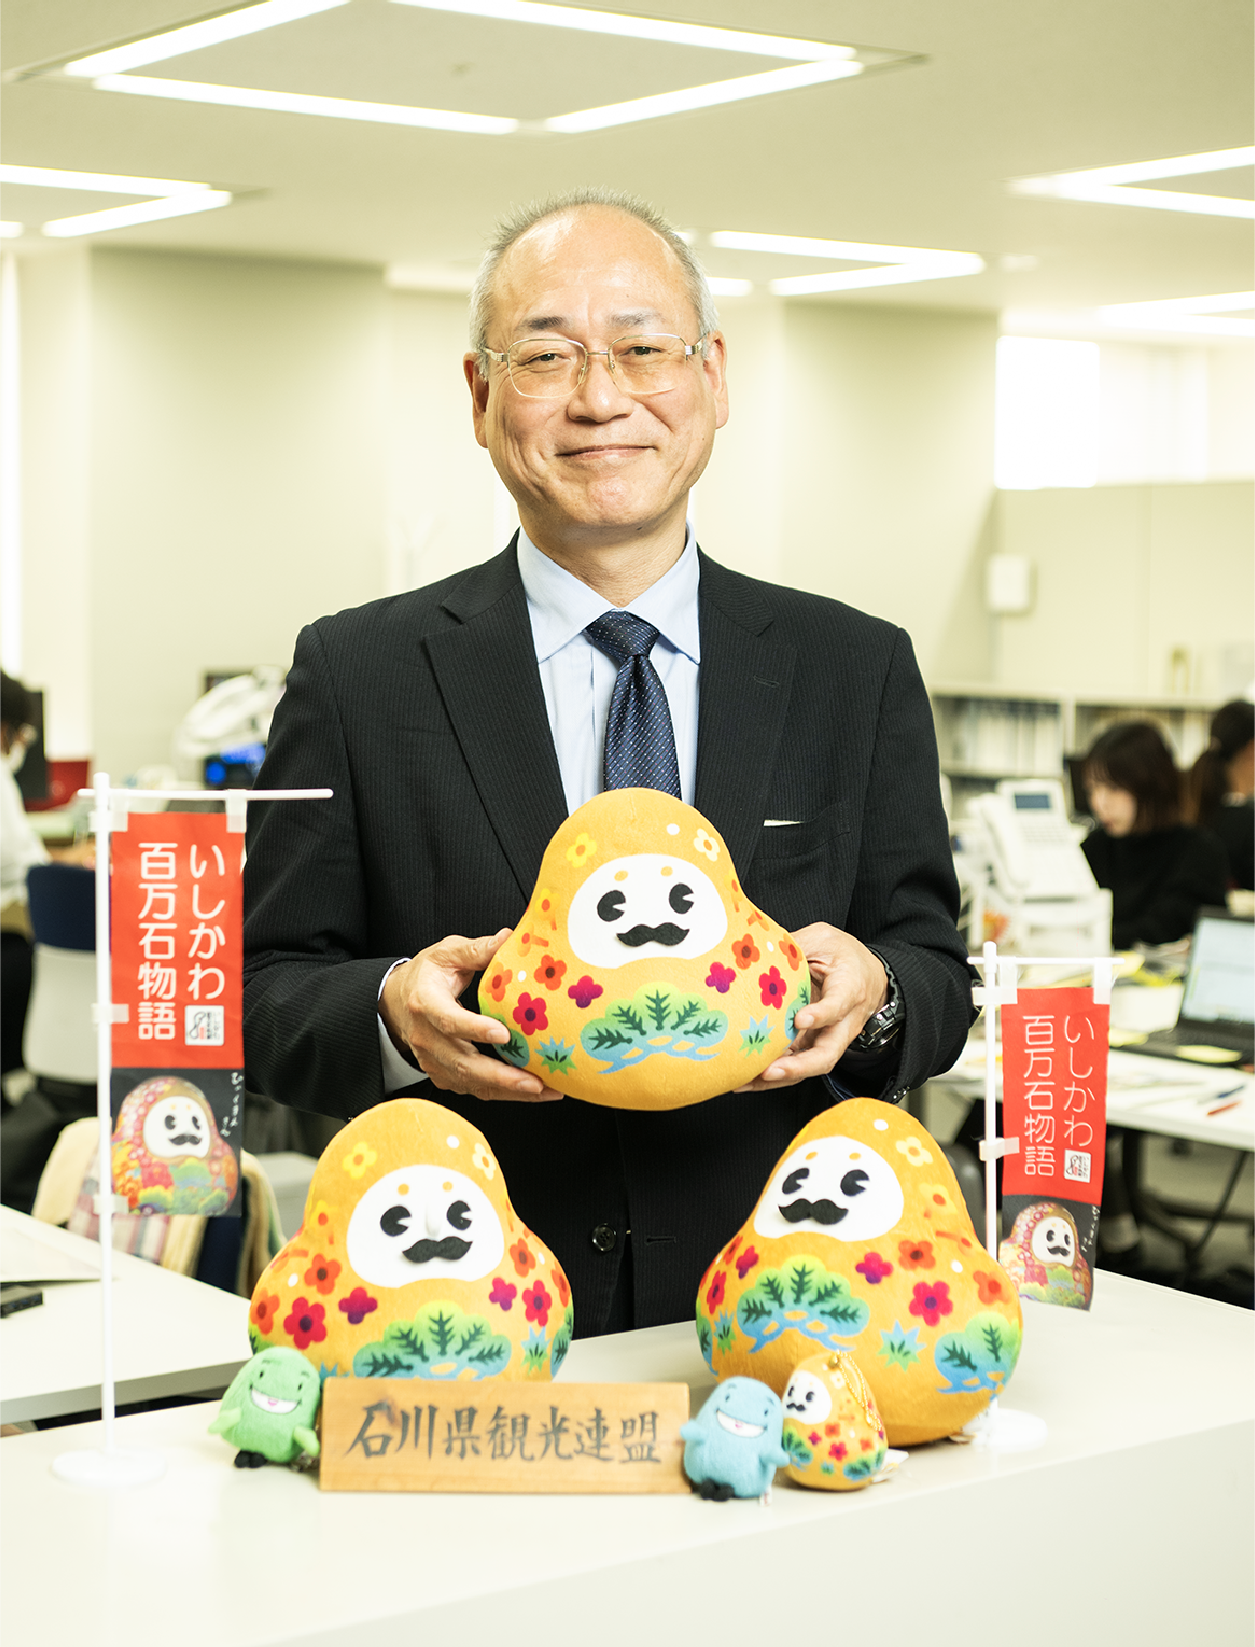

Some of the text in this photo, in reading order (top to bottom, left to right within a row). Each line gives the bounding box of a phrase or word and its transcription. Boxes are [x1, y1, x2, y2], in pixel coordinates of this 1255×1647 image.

[137, 842, 179, 1041] 百万石物語
[187, 843, 226, 1001] いしかわ
[1022, 1015, 1057, 1177] 百万石物語
[1063, 1015, 1096, 1148] いしかわ
[344, 1397, 662, 1466] 石川県観光連盟
